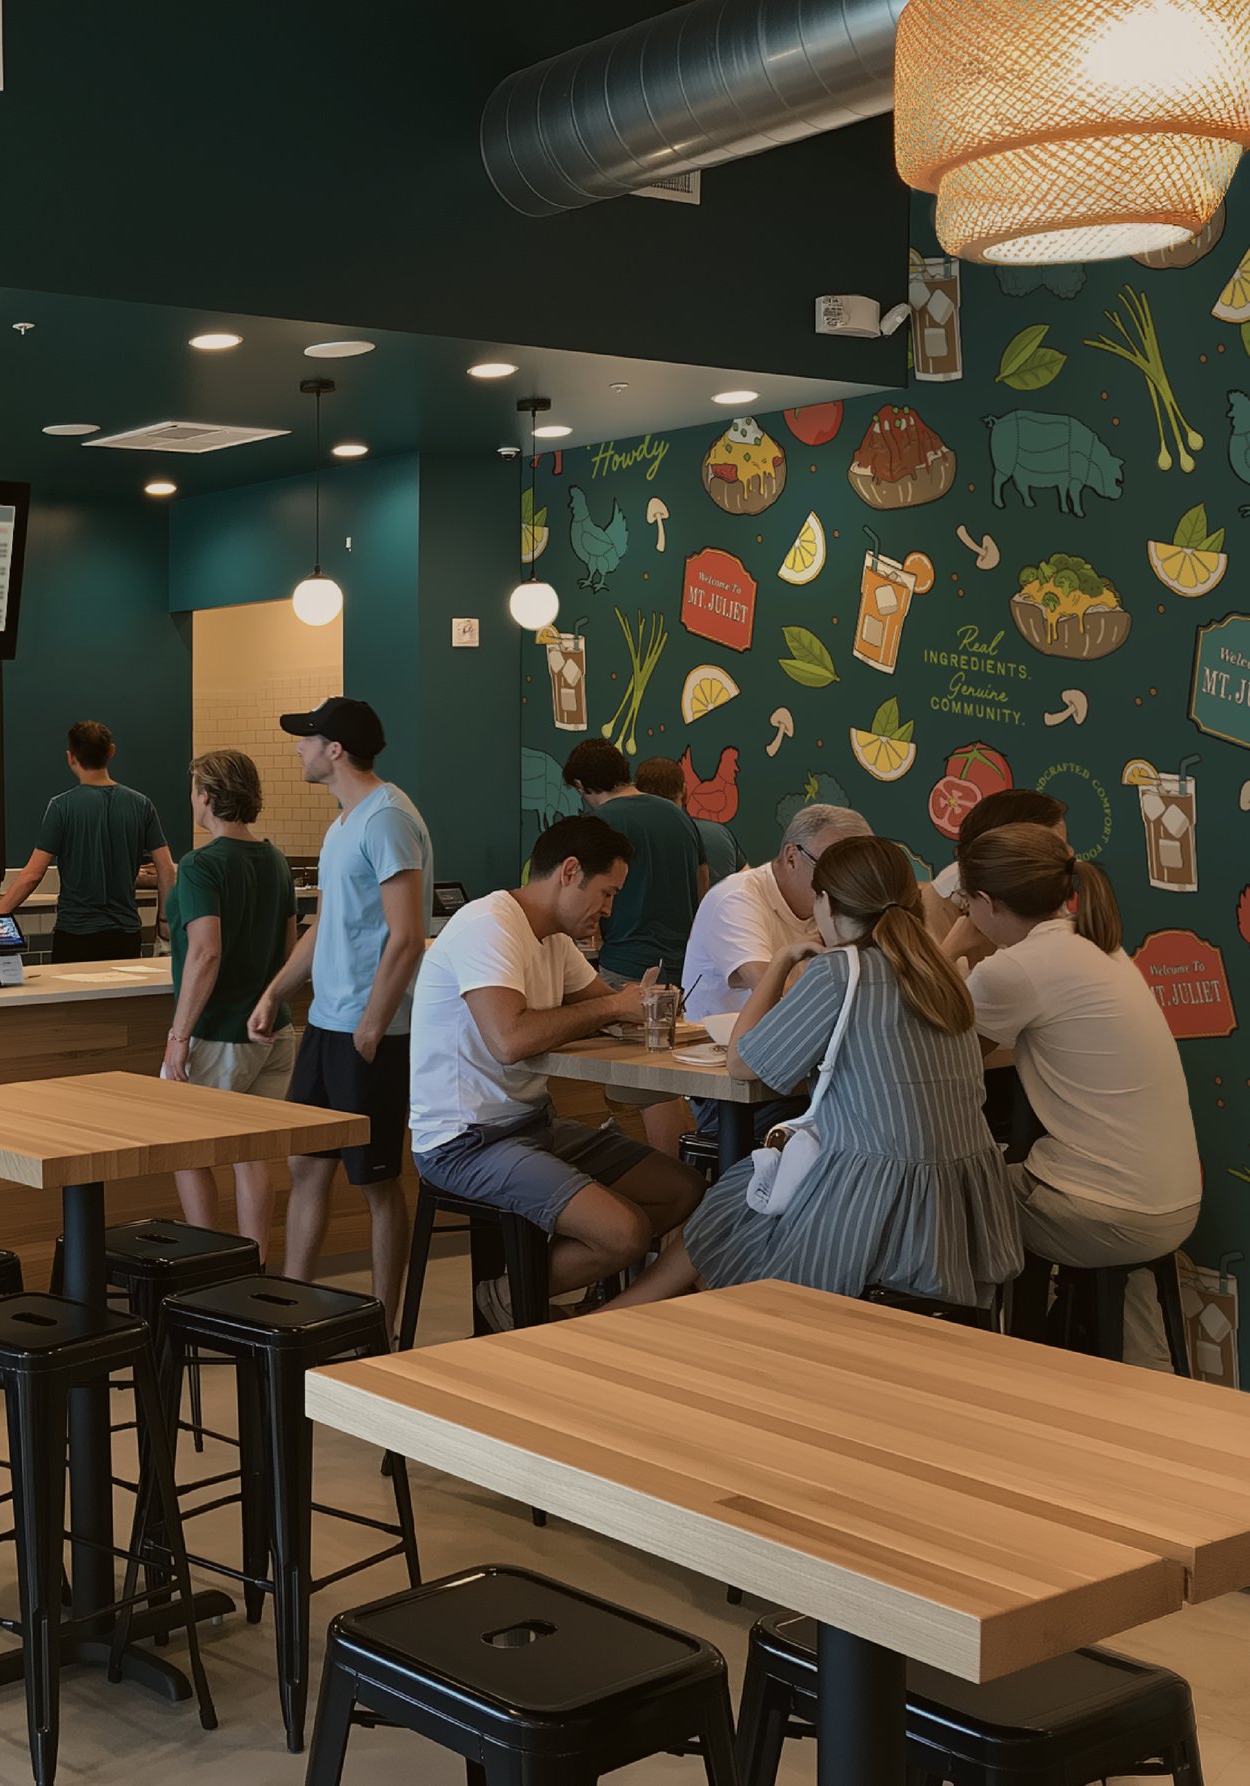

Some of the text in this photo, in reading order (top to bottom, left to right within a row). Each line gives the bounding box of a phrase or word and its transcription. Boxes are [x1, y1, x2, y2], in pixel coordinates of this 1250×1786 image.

[591, 435, 669, 481] Howdy
[699, 571, 742, 594] Welcome To
[688, 586, 748, 624] MT. JULIET
[957, 625, 1005, 655] Real
[924, 649, 1032, 680] INGREDIENTS.
[947, 671, 1008, 702] Genuine
[1202, 666, 1250, 708] MT. J
[930, 696, 1026, 725] COMMUNITY.
[1092, 779, 1112, 844] COMFORT
[1150, 961, 1205, 977] Welcome To
[1150, 980, 1221, 1007] T. JULIET
